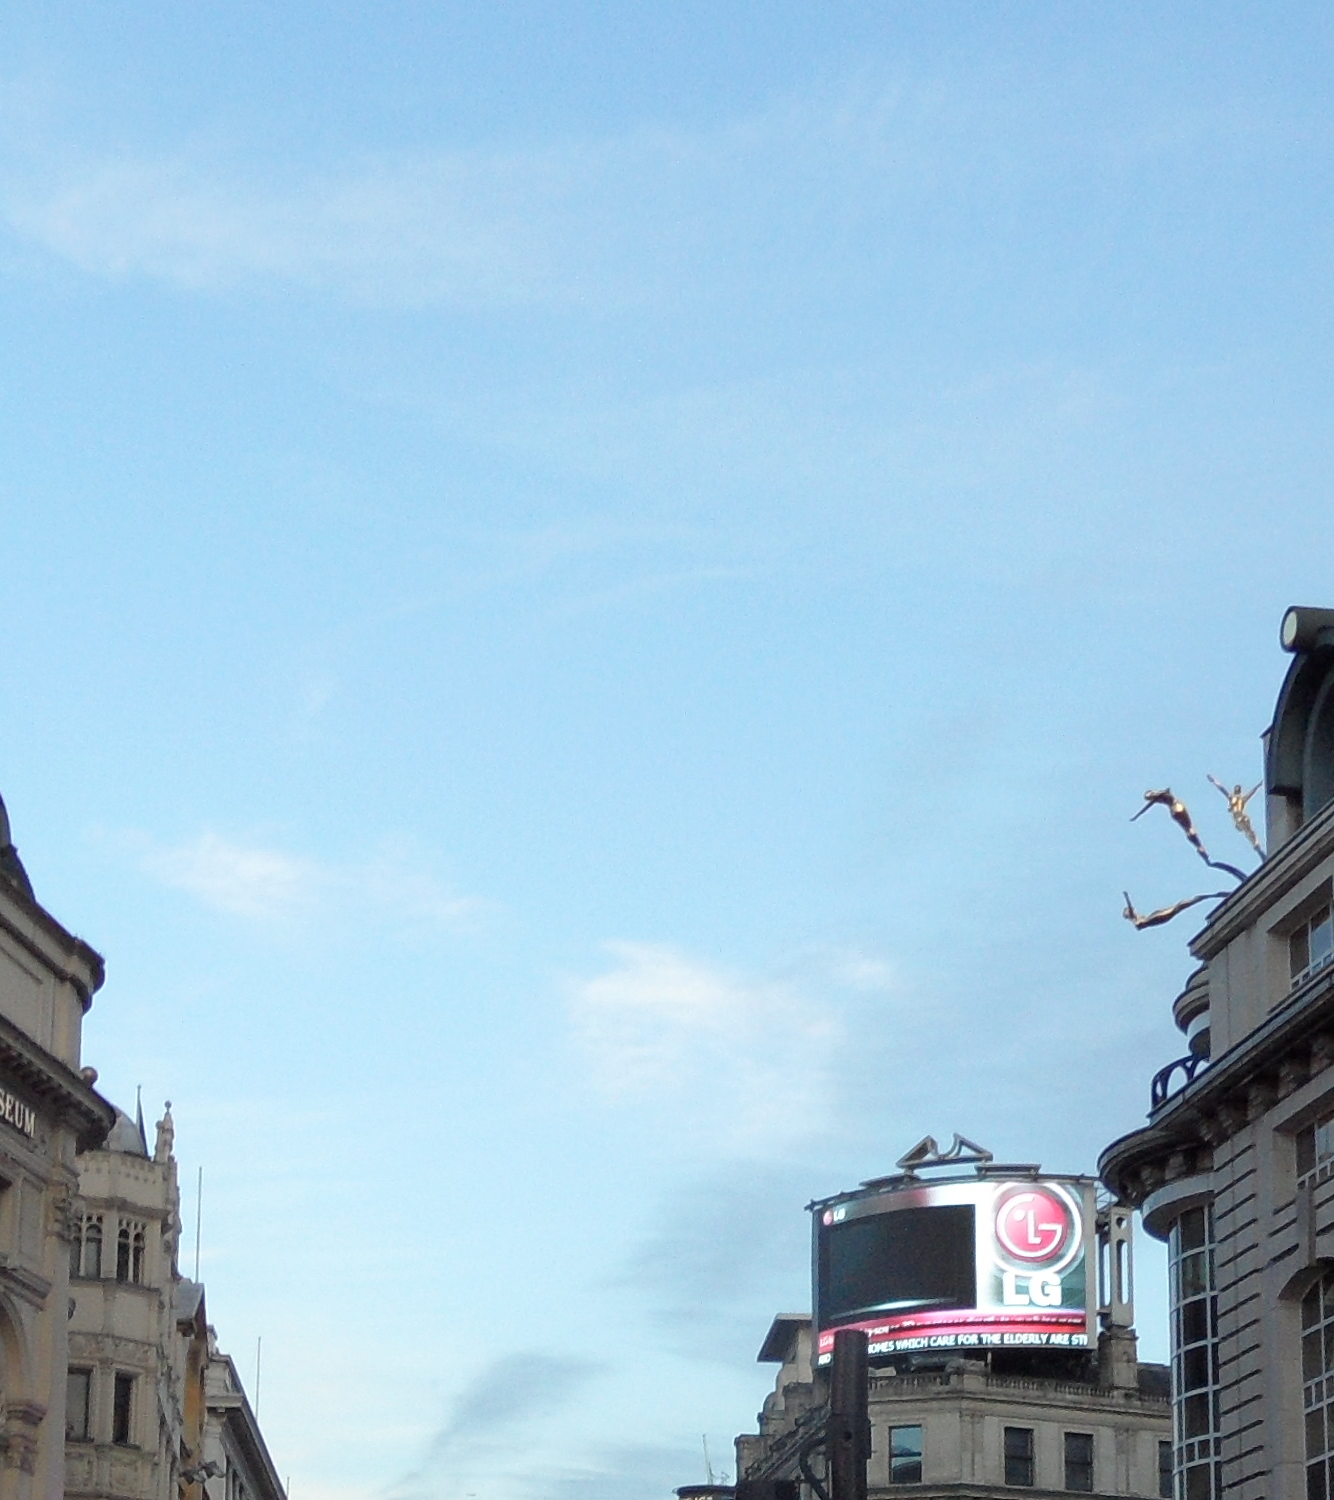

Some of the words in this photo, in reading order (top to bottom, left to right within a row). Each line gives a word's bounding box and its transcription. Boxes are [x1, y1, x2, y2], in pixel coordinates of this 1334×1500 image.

[1002, 1271, 1063, 1307] LG
[895, 1336, 928, 1351] WHICH
[929, 1334, 957, 1347] CARE
[957, 1333, 979, 1345] FOR
[980, 1333, 1002, 1345] THE
[1003, 1332, 1049, 1345] ELDERLY
[1049, 1333, 1070, 1345] ARE
